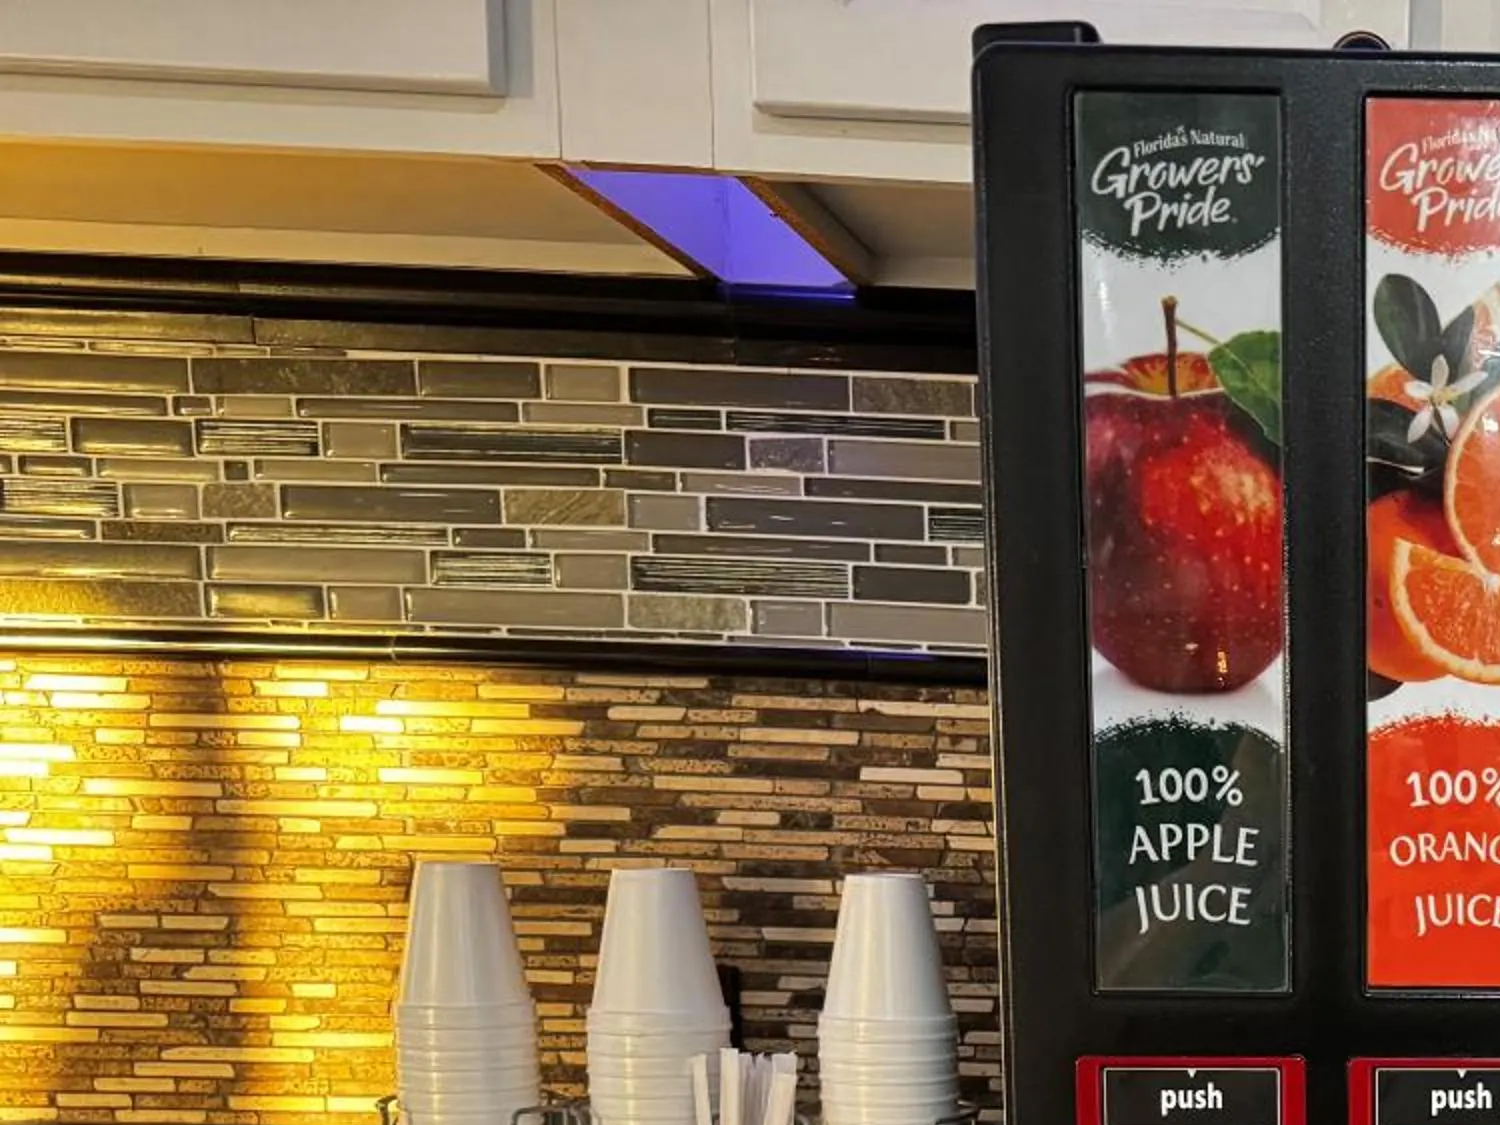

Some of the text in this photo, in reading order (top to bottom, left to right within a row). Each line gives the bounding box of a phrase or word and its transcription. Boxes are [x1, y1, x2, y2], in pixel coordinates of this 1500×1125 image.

[1190, 128, 1245, 150] Natural
[1134, 764, 1244, 807] 100%
[1128, 823, 1260, 867] APPLE
[1134, 884, 1252, 933] JUICE
[1159, 1081, 1224, 1116] push
[1430, 1081, 1494, 1117] push
